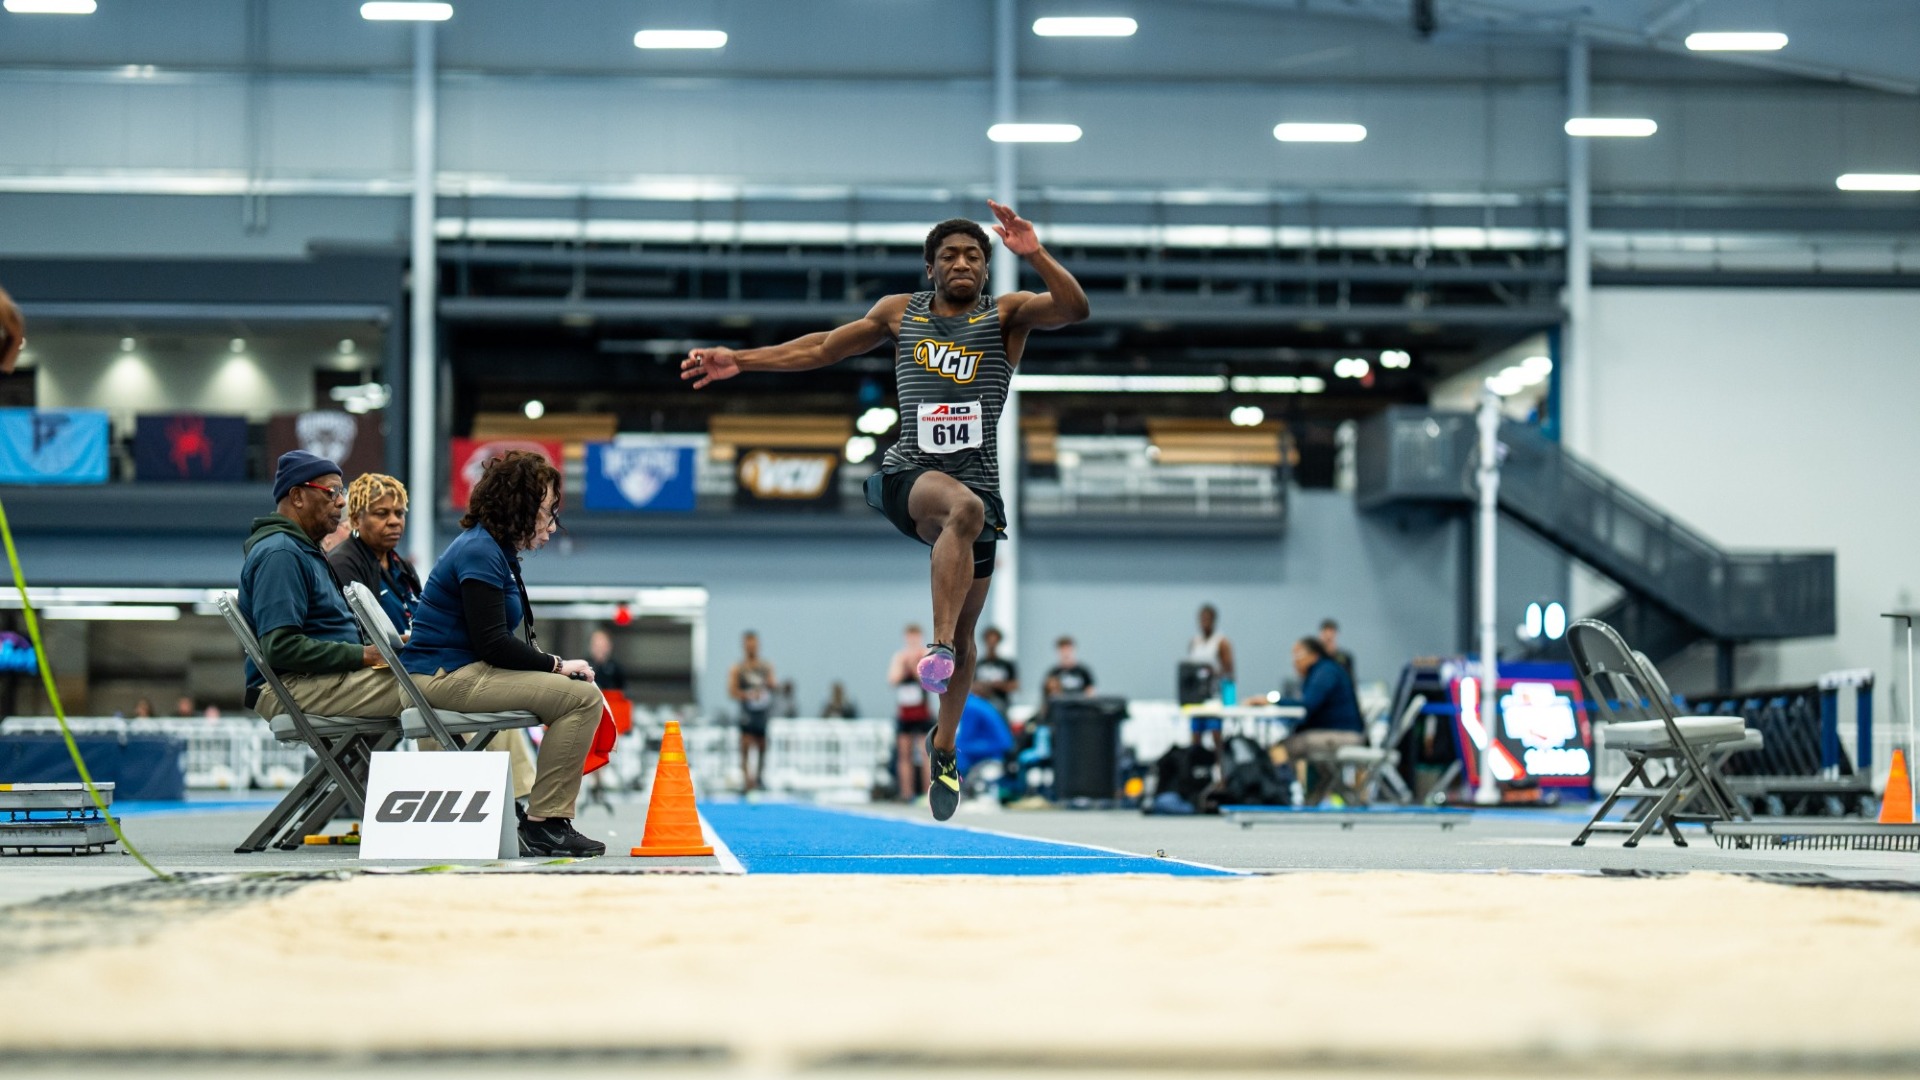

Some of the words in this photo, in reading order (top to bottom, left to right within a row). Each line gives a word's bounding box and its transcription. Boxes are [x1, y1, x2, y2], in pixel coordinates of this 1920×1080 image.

[915, 340, 982, 382] VCU
[933, 424, 970, 446] 614
[375, 791, 491, 822] GILL
